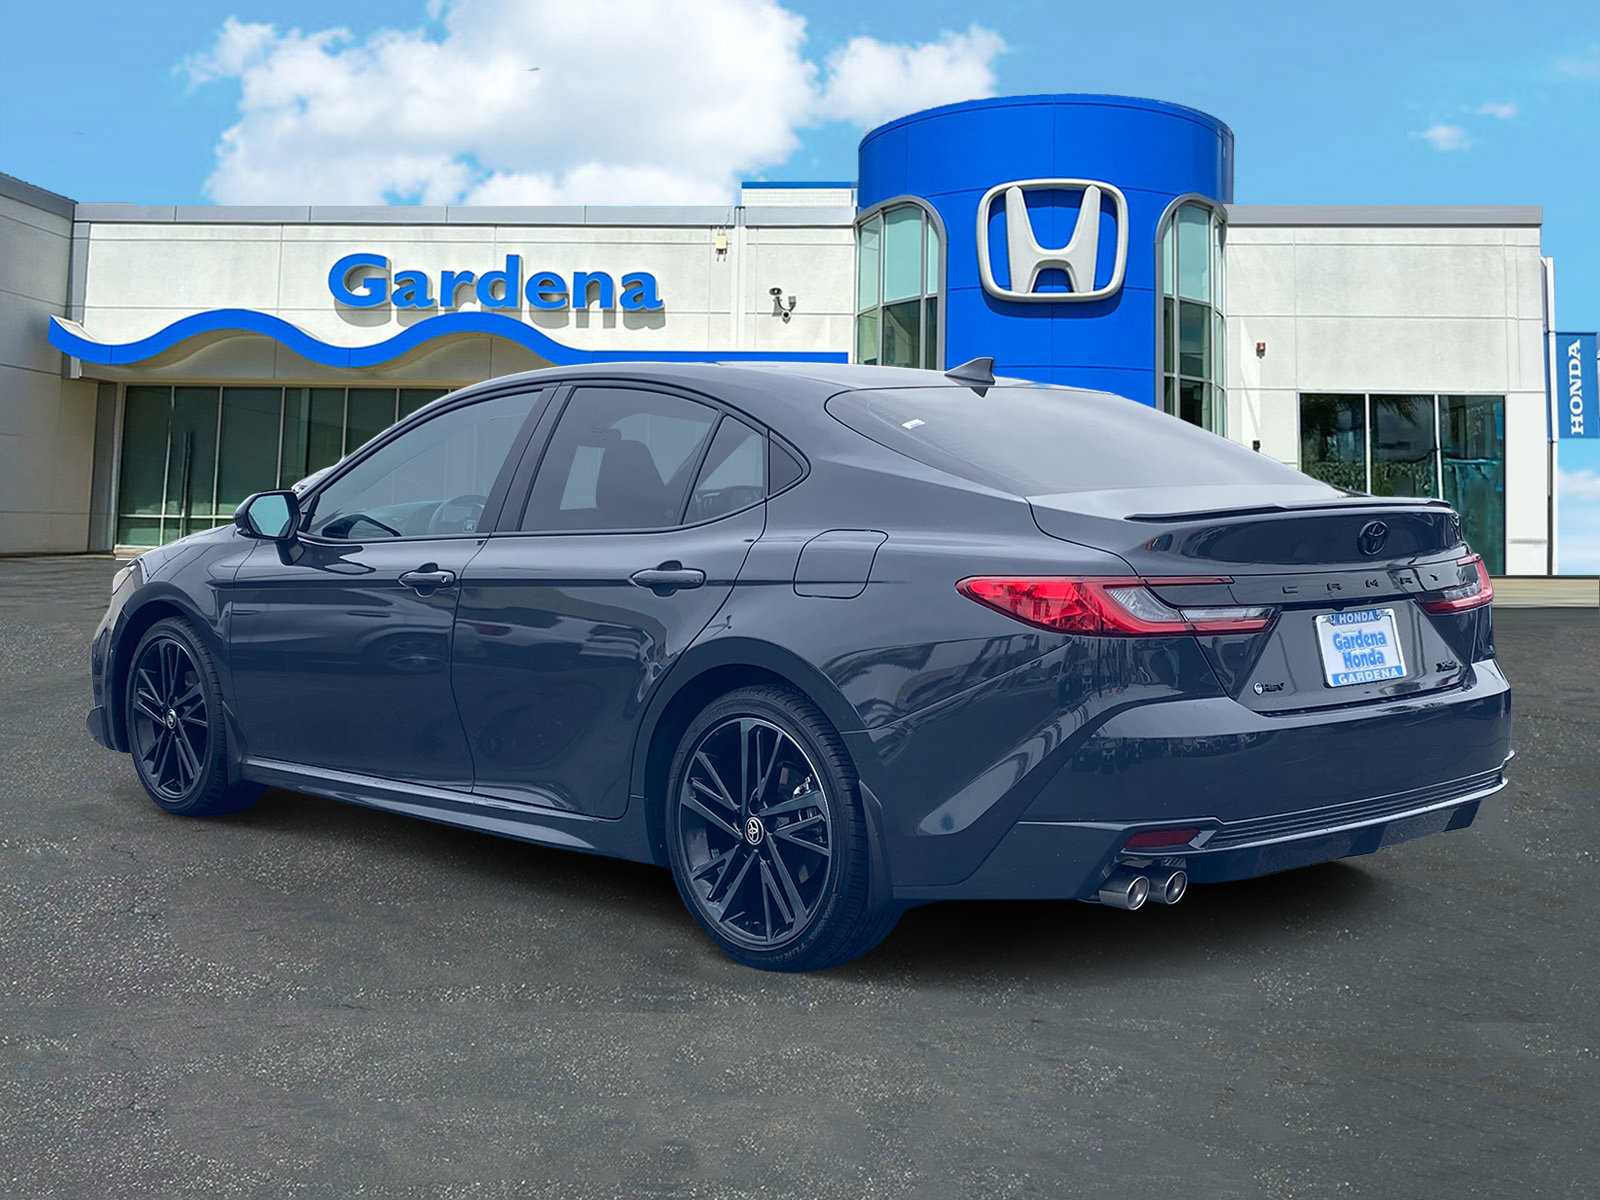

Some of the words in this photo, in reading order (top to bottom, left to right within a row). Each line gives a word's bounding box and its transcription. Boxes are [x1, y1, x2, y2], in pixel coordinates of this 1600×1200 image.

[328, 252, 664, 309] Gardena
[1568, 339, 1584, 435] HONDA
[1338, 611, 1375, 625] HONDA
[1333, 629, 1387, 651] Gardena
[1342, 649, 1385, 669] Honda
[1338, 668, 1398, 684] GARDENA
